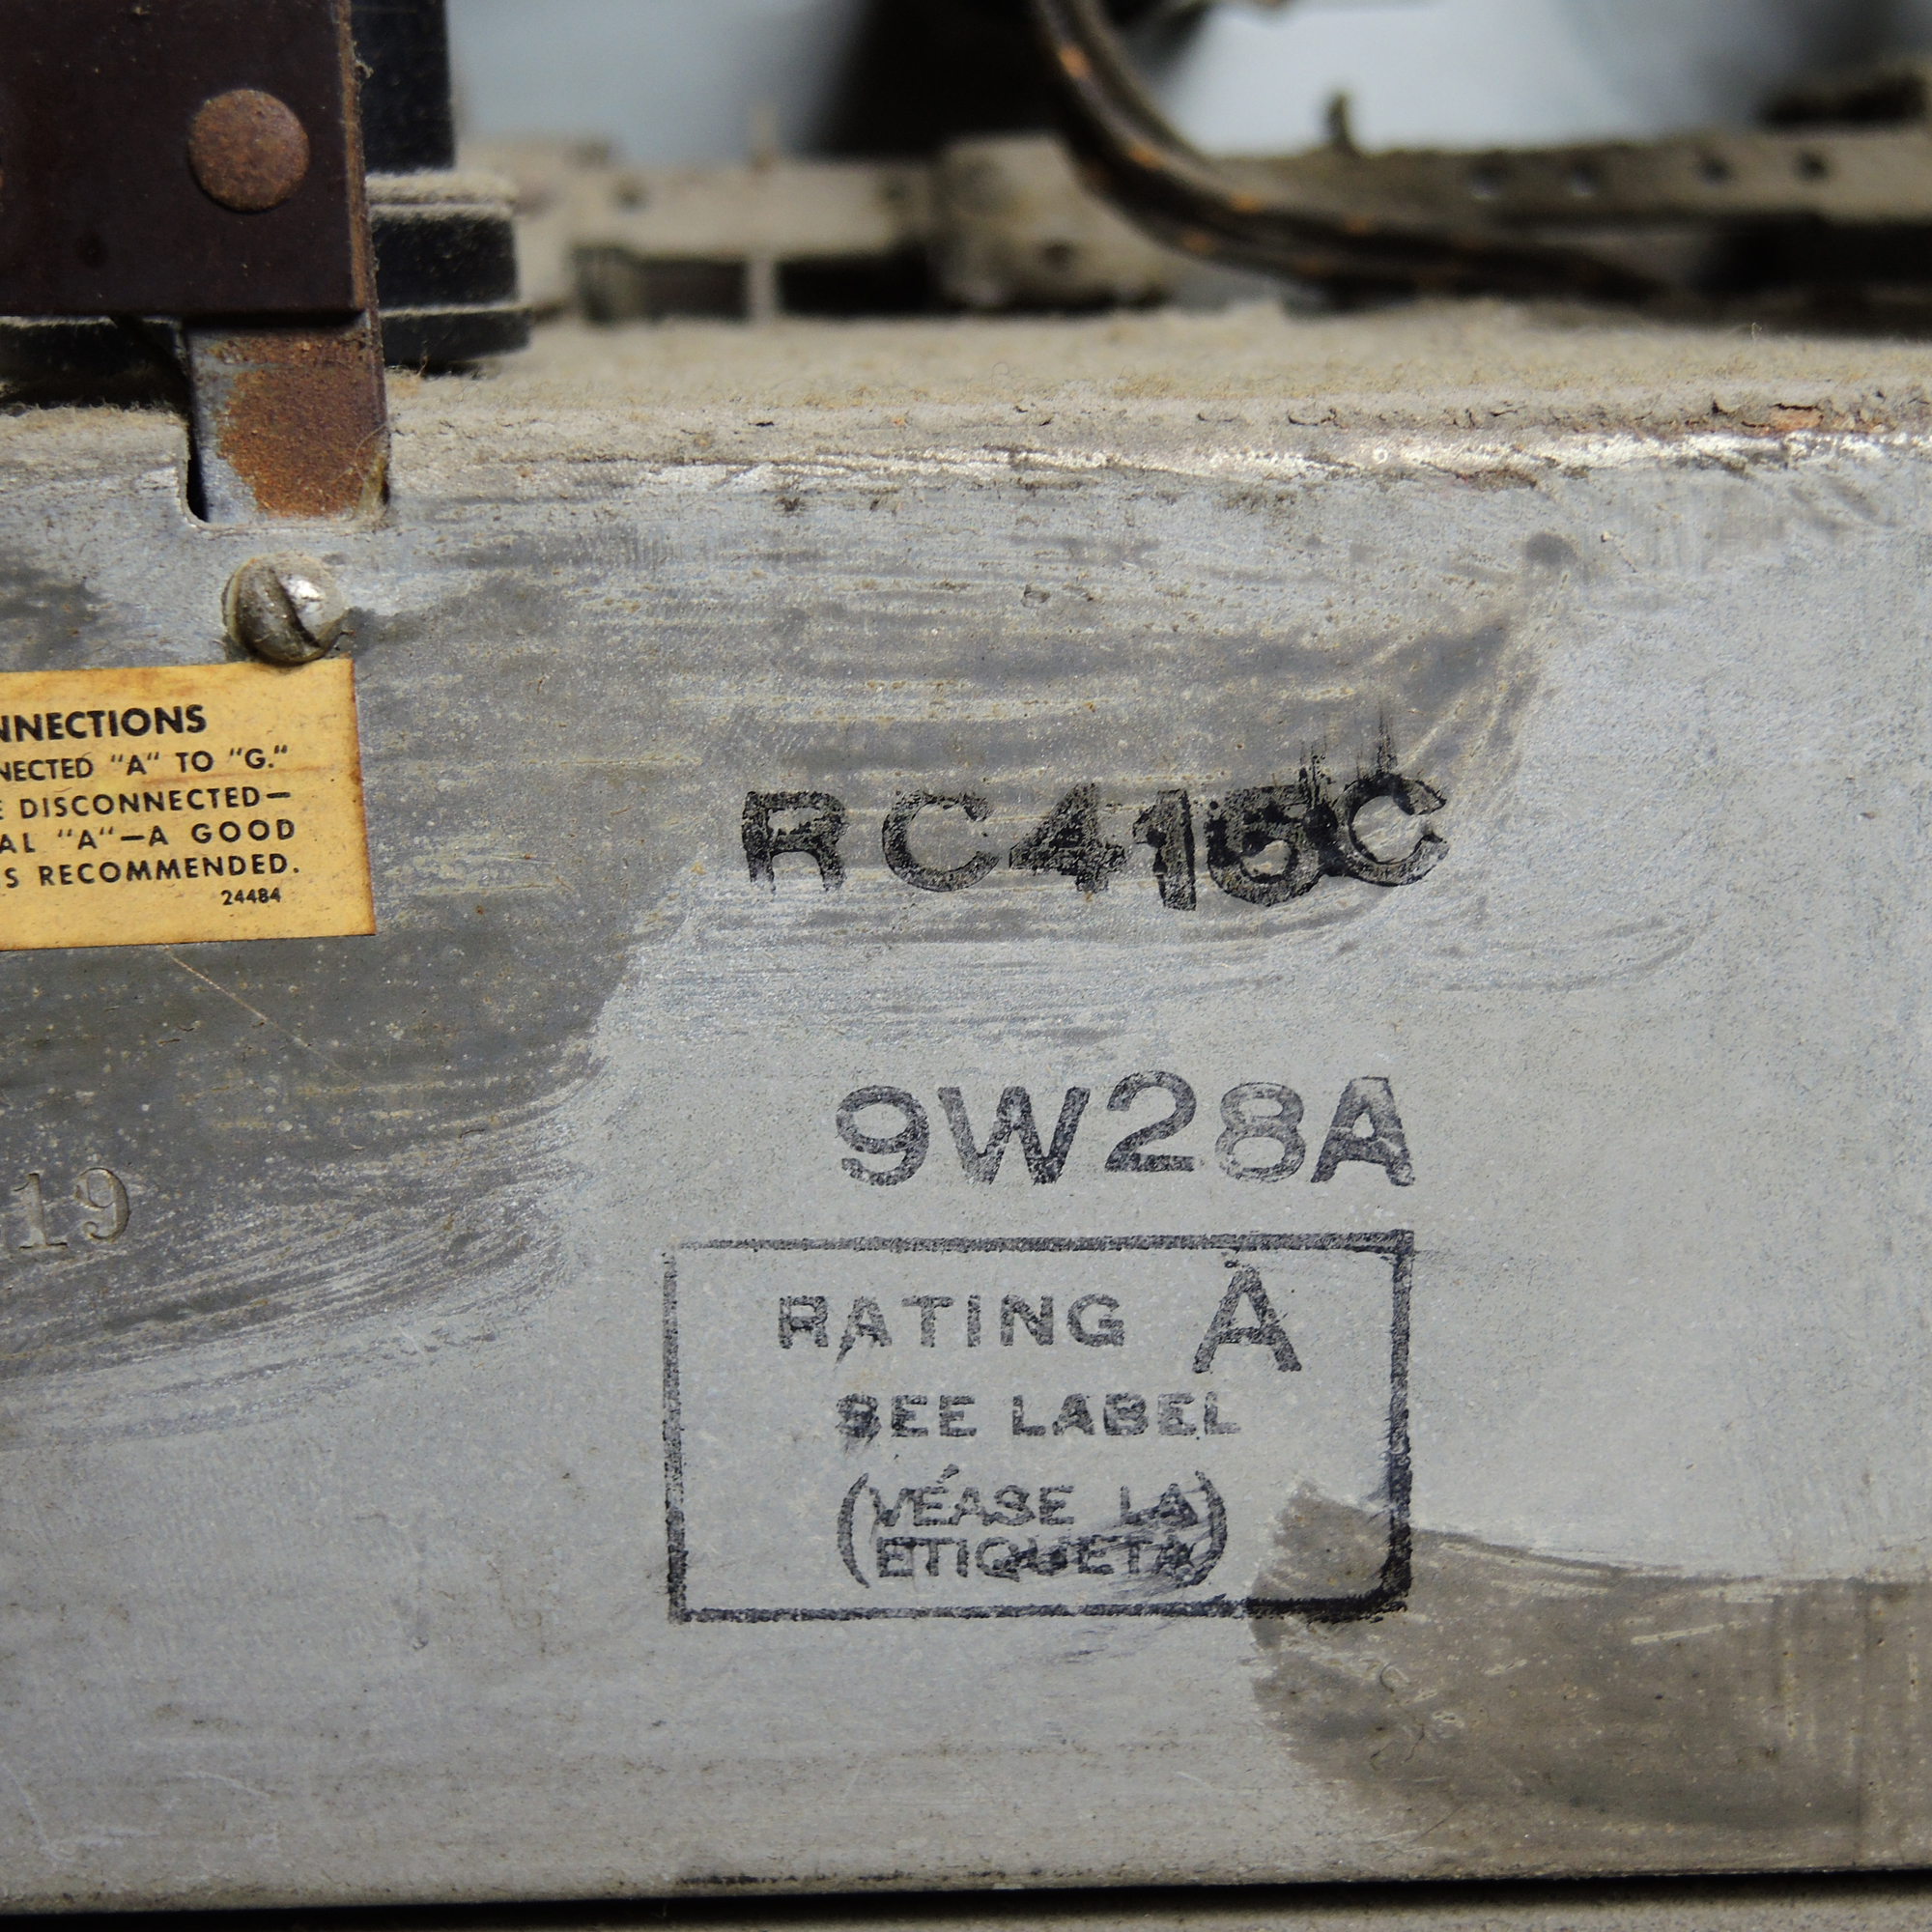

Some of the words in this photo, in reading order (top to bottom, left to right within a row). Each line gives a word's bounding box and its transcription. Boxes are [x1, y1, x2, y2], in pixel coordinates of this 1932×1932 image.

[176, 751, 213, 773] TO
[191, 819, 296, 844] GOOD
[38, 852, 300, 886] RECOMMENDED.
[220, 887, 282, 906] 24484
[836, 1070, 1415, 1186] 9W28A
[777, 1292, 1126, 1356] RATING
[1192, 1261, 1302, 1372] A
[837, 1393, 978, 1441] SEE
[1012, 1390, 1240, 1438] LABEL
